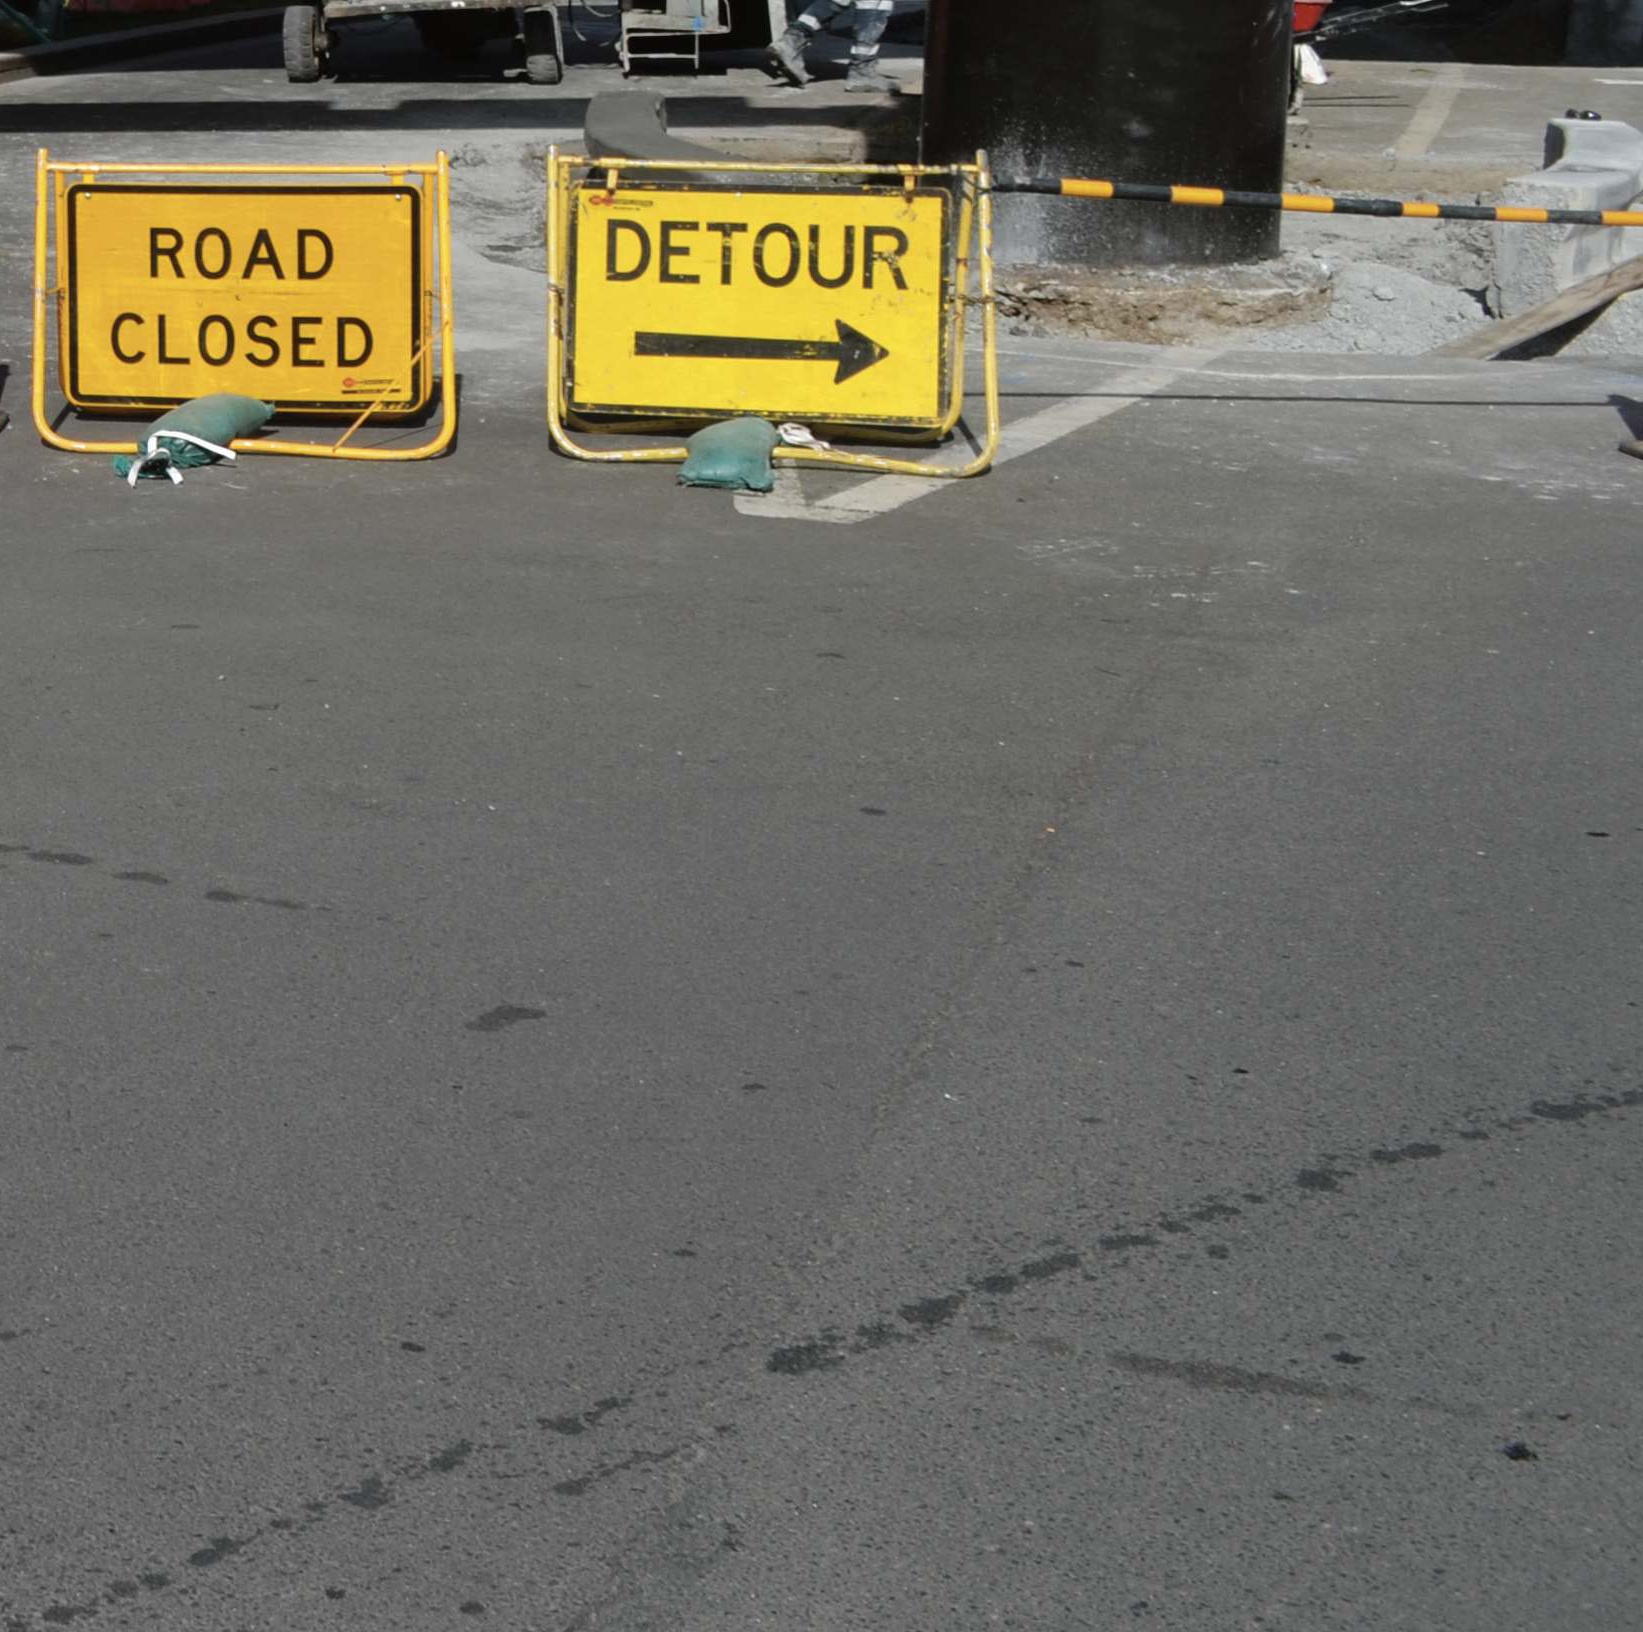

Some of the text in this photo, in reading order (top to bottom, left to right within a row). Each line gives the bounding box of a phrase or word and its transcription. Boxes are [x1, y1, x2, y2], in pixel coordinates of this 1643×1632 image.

[149, 226, 335, 280] ROAD
[605, 218, 909, 290] DETOUR
[110, 311, 375, 369] CLOSED
